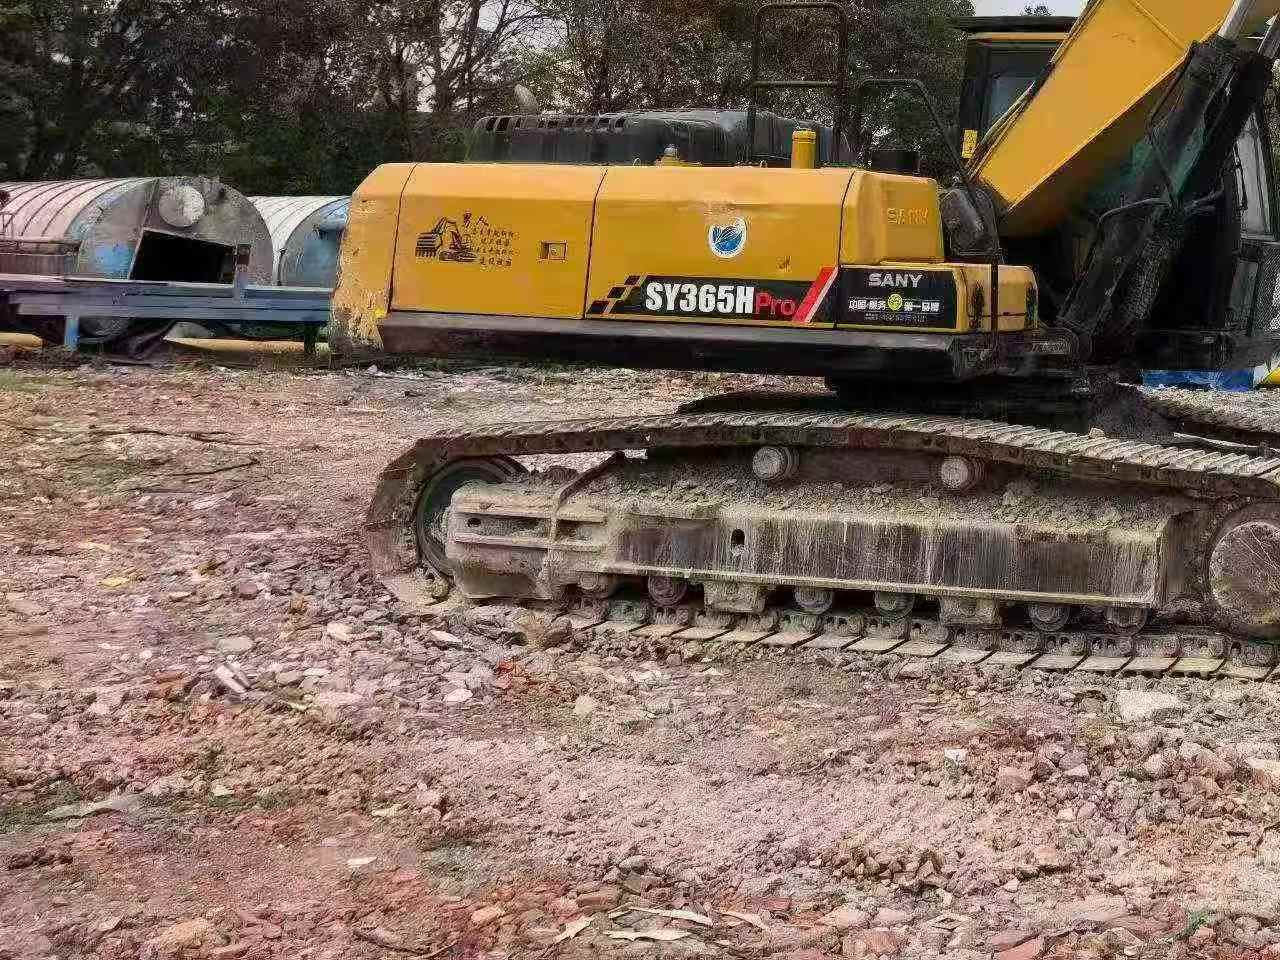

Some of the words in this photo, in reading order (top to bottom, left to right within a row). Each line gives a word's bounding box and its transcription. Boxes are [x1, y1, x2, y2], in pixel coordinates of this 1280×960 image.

[868, 273, 923, 288] SANY
[645, 281, 754, 314] SY365H
[755, 292, 796, 316] Pro
